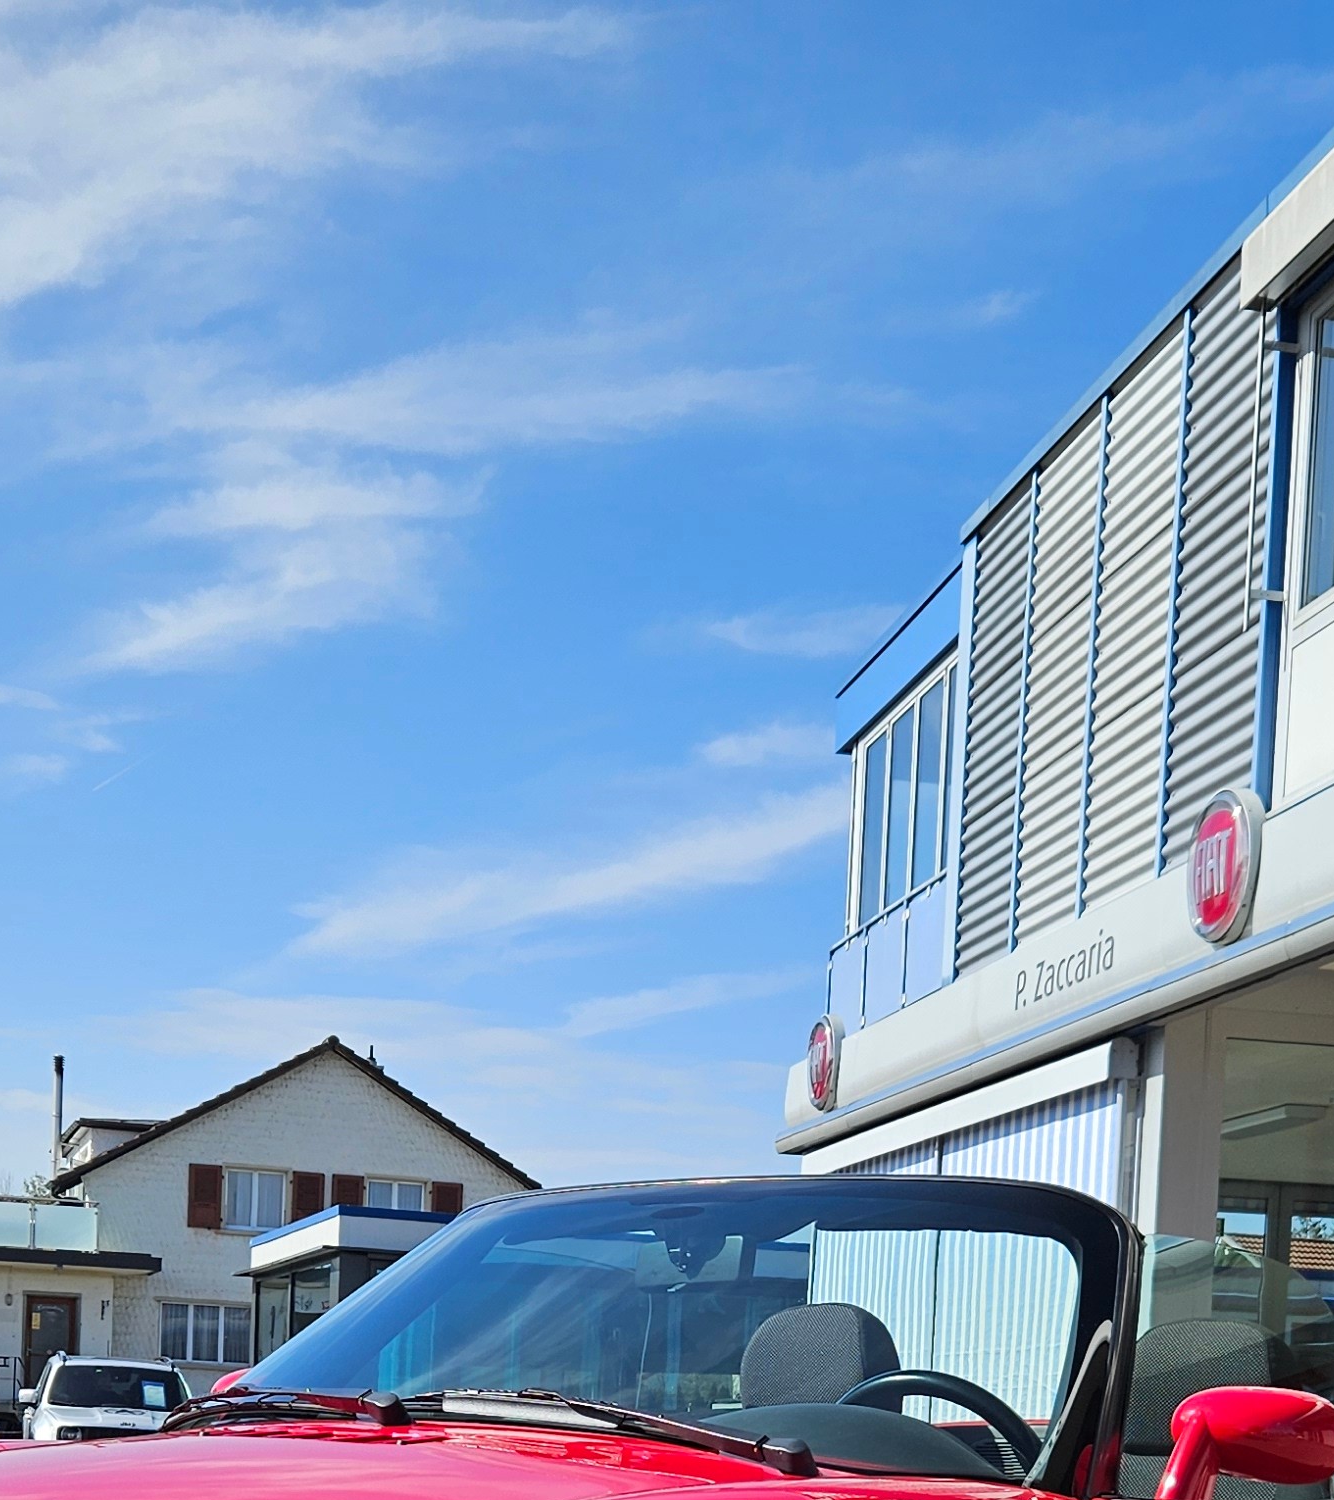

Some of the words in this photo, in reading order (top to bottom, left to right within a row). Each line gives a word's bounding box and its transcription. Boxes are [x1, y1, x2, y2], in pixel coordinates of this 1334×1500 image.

[1196, 827, 1233, 905] FIAT
[1014, 969, 1027, 1011] P.
[1033, 928, 1115, 1003] Zaccaria
